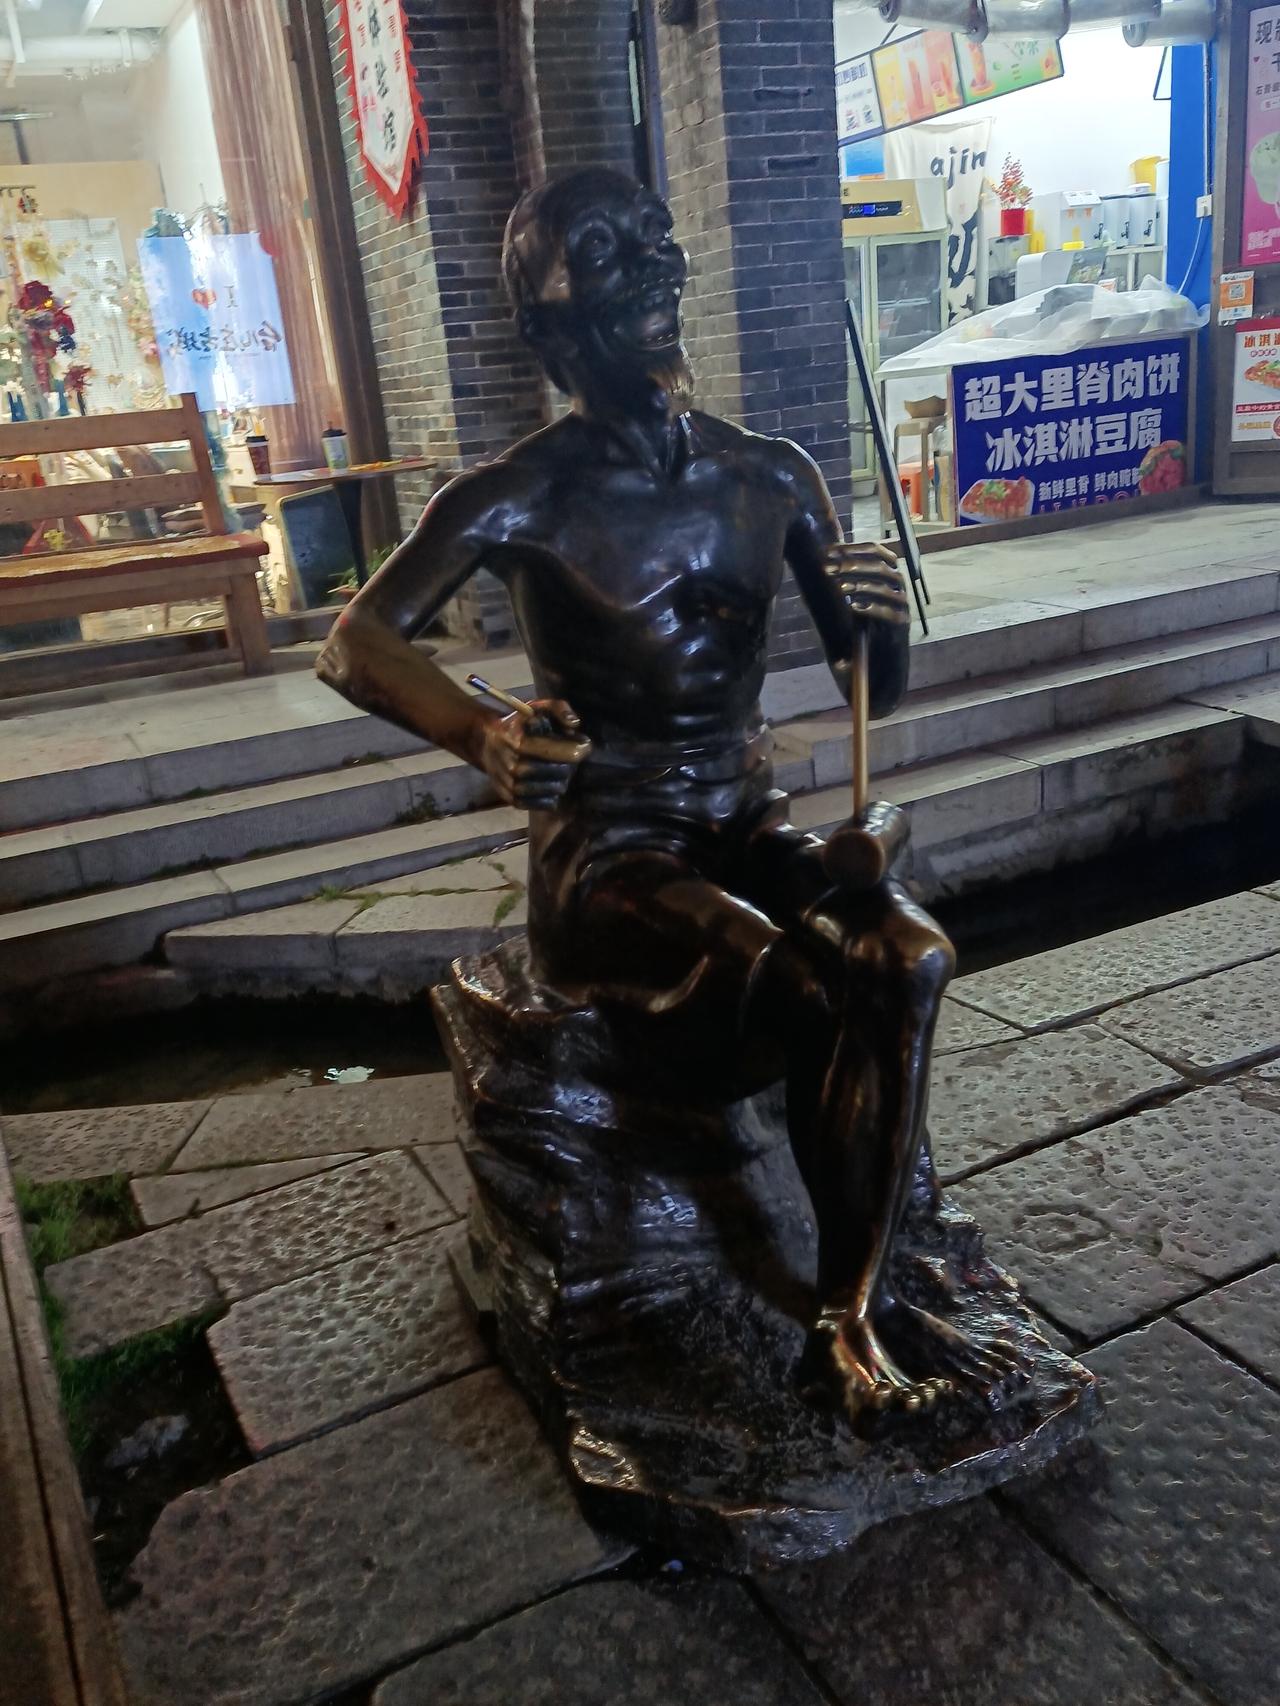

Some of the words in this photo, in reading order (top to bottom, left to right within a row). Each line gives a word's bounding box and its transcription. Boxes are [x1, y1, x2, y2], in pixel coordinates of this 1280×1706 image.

[964, 352, 1181, 423] 超大里脊肉饼
[985, 407, 1163, 473] 冰淇淋豆腐
